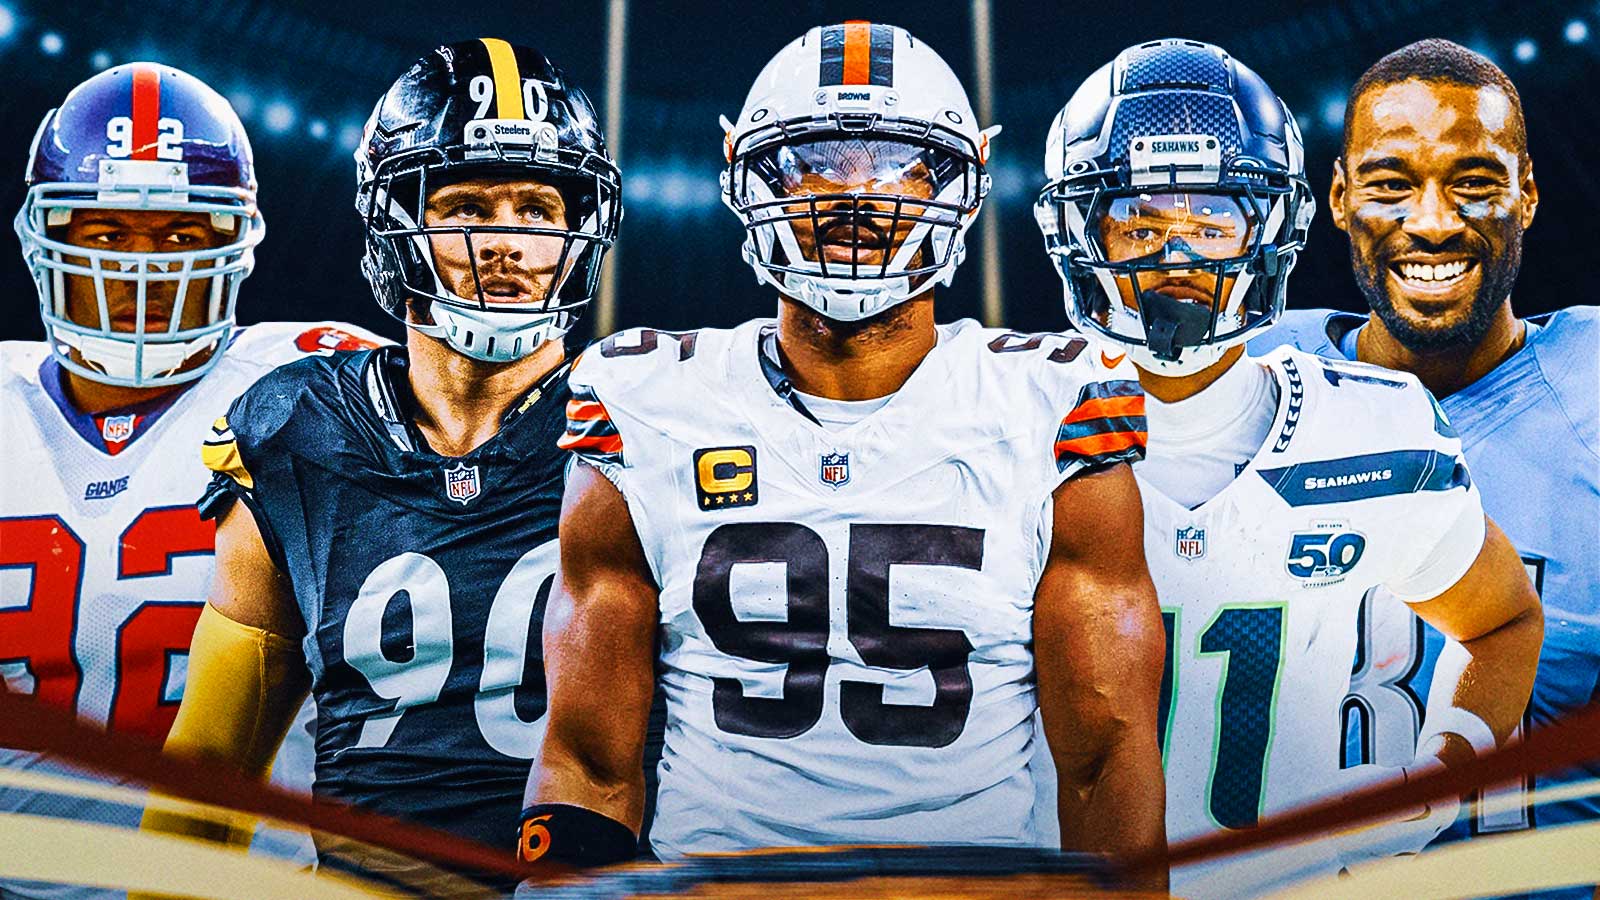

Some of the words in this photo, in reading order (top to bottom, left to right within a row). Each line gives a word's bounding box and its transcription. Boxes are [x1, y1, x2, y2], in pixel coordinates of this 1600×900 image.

[494, 124, 531, 136] Steelers
[1151, 141, 1200, 153] SEAHAWKS
[698, 449, 753, 494] C
[824, 466, 846, 482] NFL
[1304, 469, 1393, 490] SEAHAWKS
[84, 475, 130, 500] GIANTS
[452, 480, 475, 497] NFL
[1179, 540, 1202, 556] NFL
[1288, 533, 1366, 578] 50
[692, 521, 986, 749] 95
[1156, 600, 1288, 832] 1
